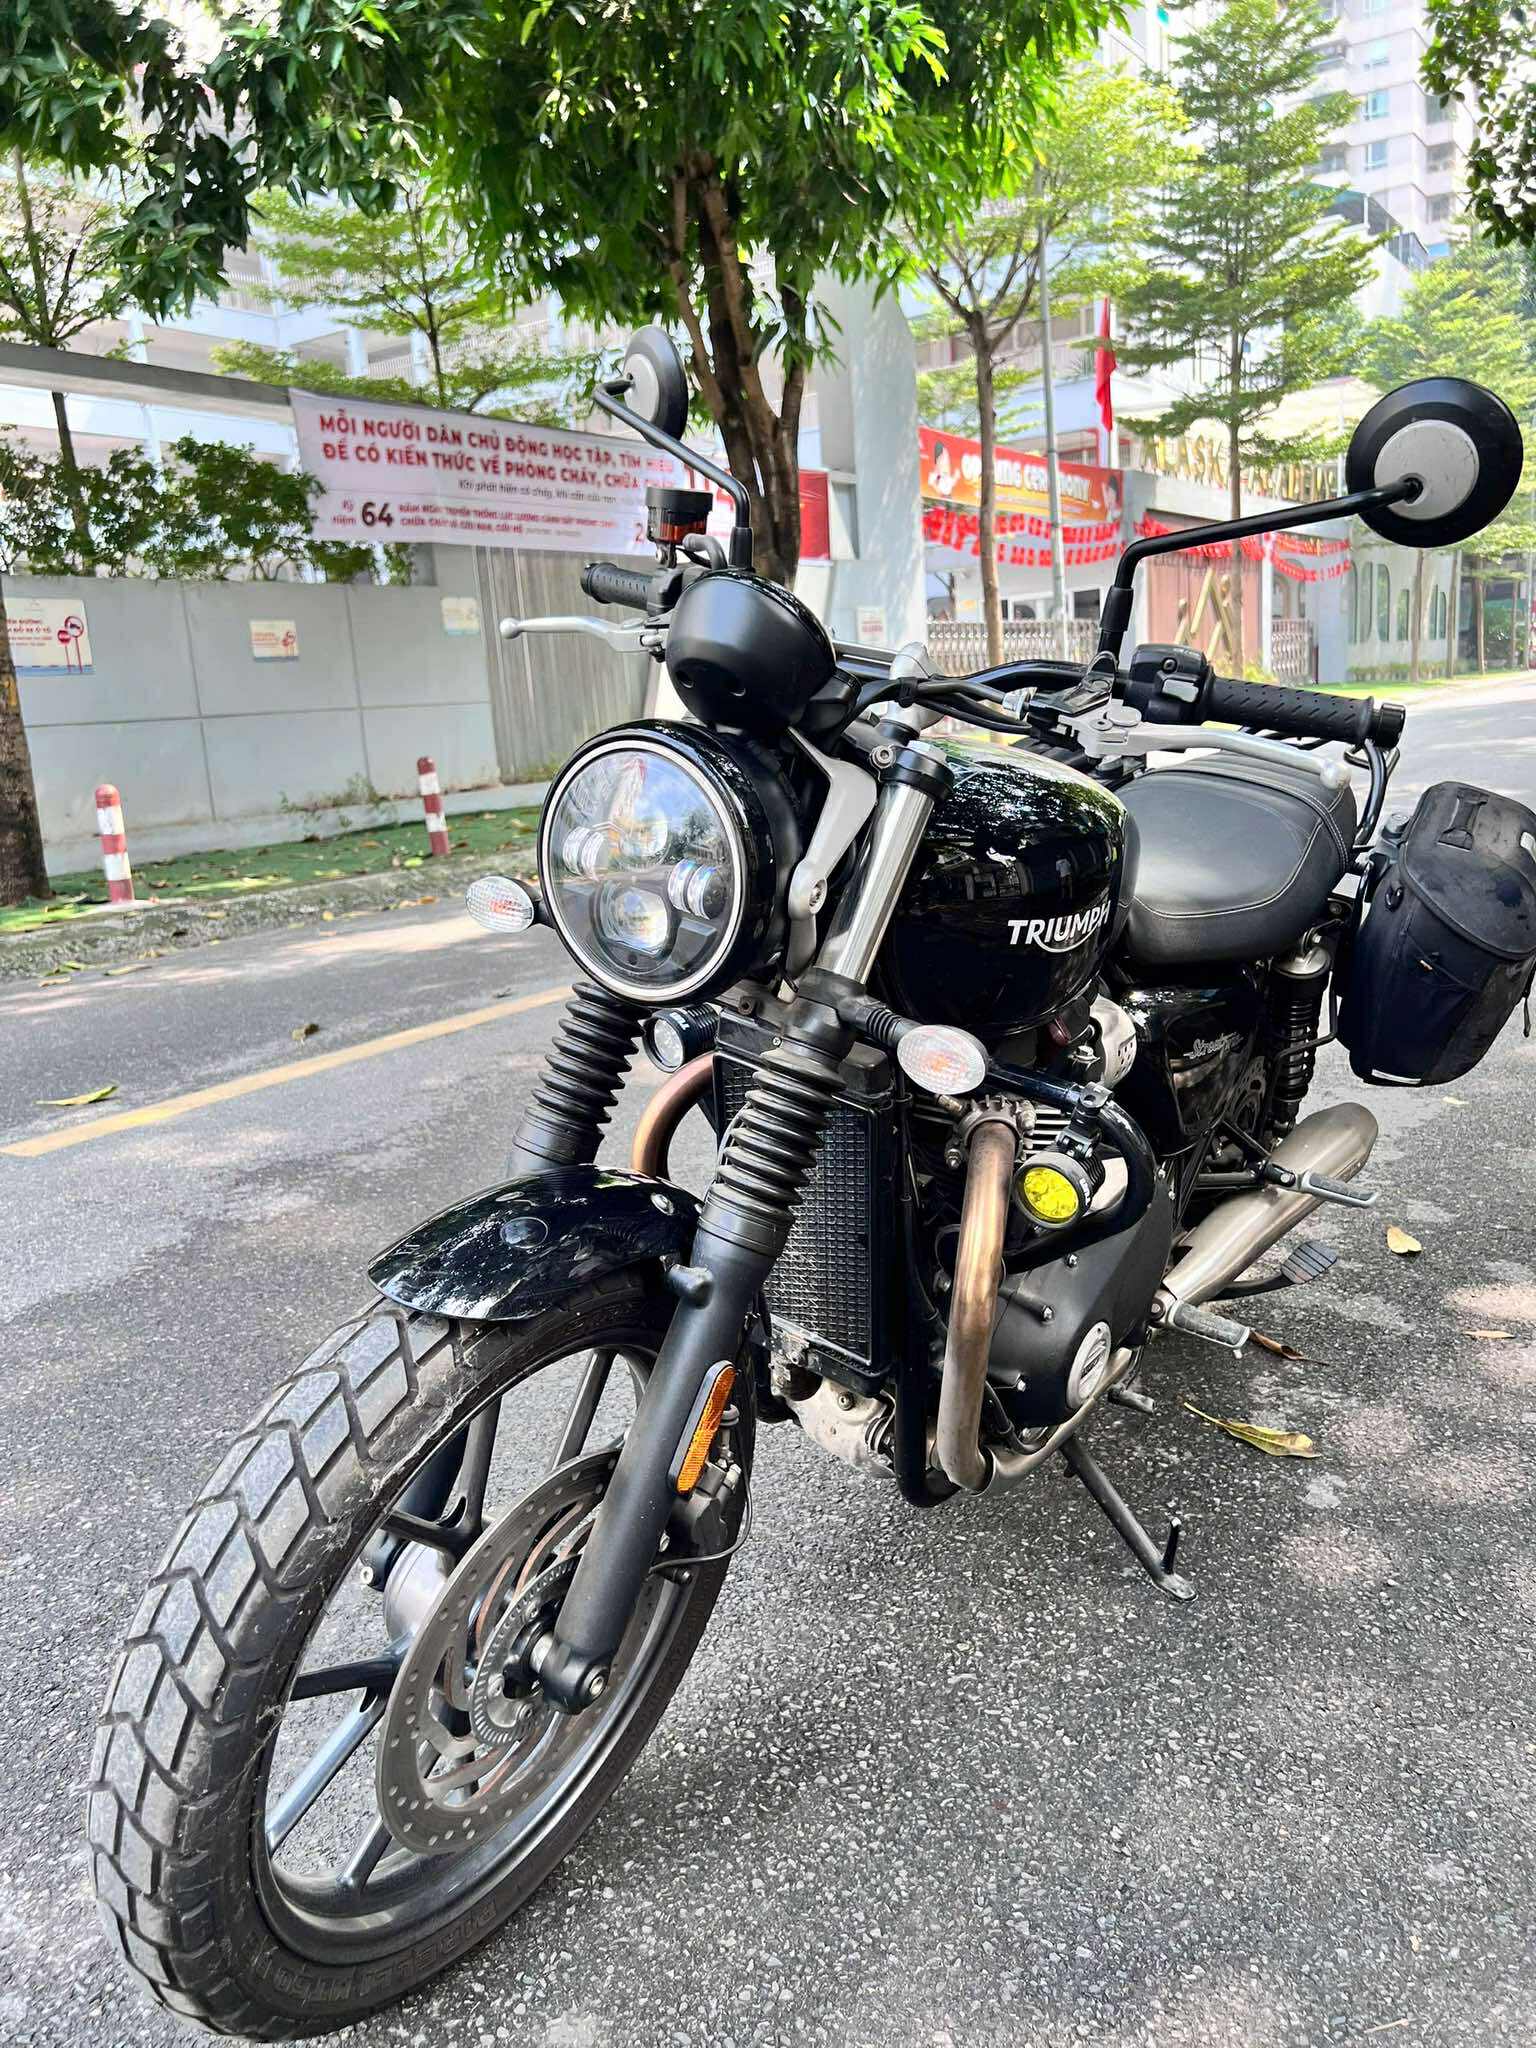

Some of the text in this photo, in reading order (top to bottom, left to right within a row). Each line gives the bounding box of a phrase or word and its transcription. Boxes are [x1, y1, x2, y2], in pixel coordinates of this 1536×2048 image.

[319, 409, 357, 434] MỖI
[363, 418, 421, 442] NGƯỜI
[427, 425, 462, 445] DÂN
[467, 429, 501, 450] CHỦ
[504, 436, 548, 458] ĐỘNG
[551, 442, 583, 464] HỌC
[355, 441, 381, 463] CÓ
[386, 444, 429, 467] KIẾN
[431, 448, 477, 472] THỨC
[480, 454, 501, 475] VỀ
[504, 459, 556, 481] PHÒNG
[961, 452, 1089, 502] OPNING CERMONY
[361, 501, 394, 528] 64
[1007, 900, 1111, 953] TRIUMPH
